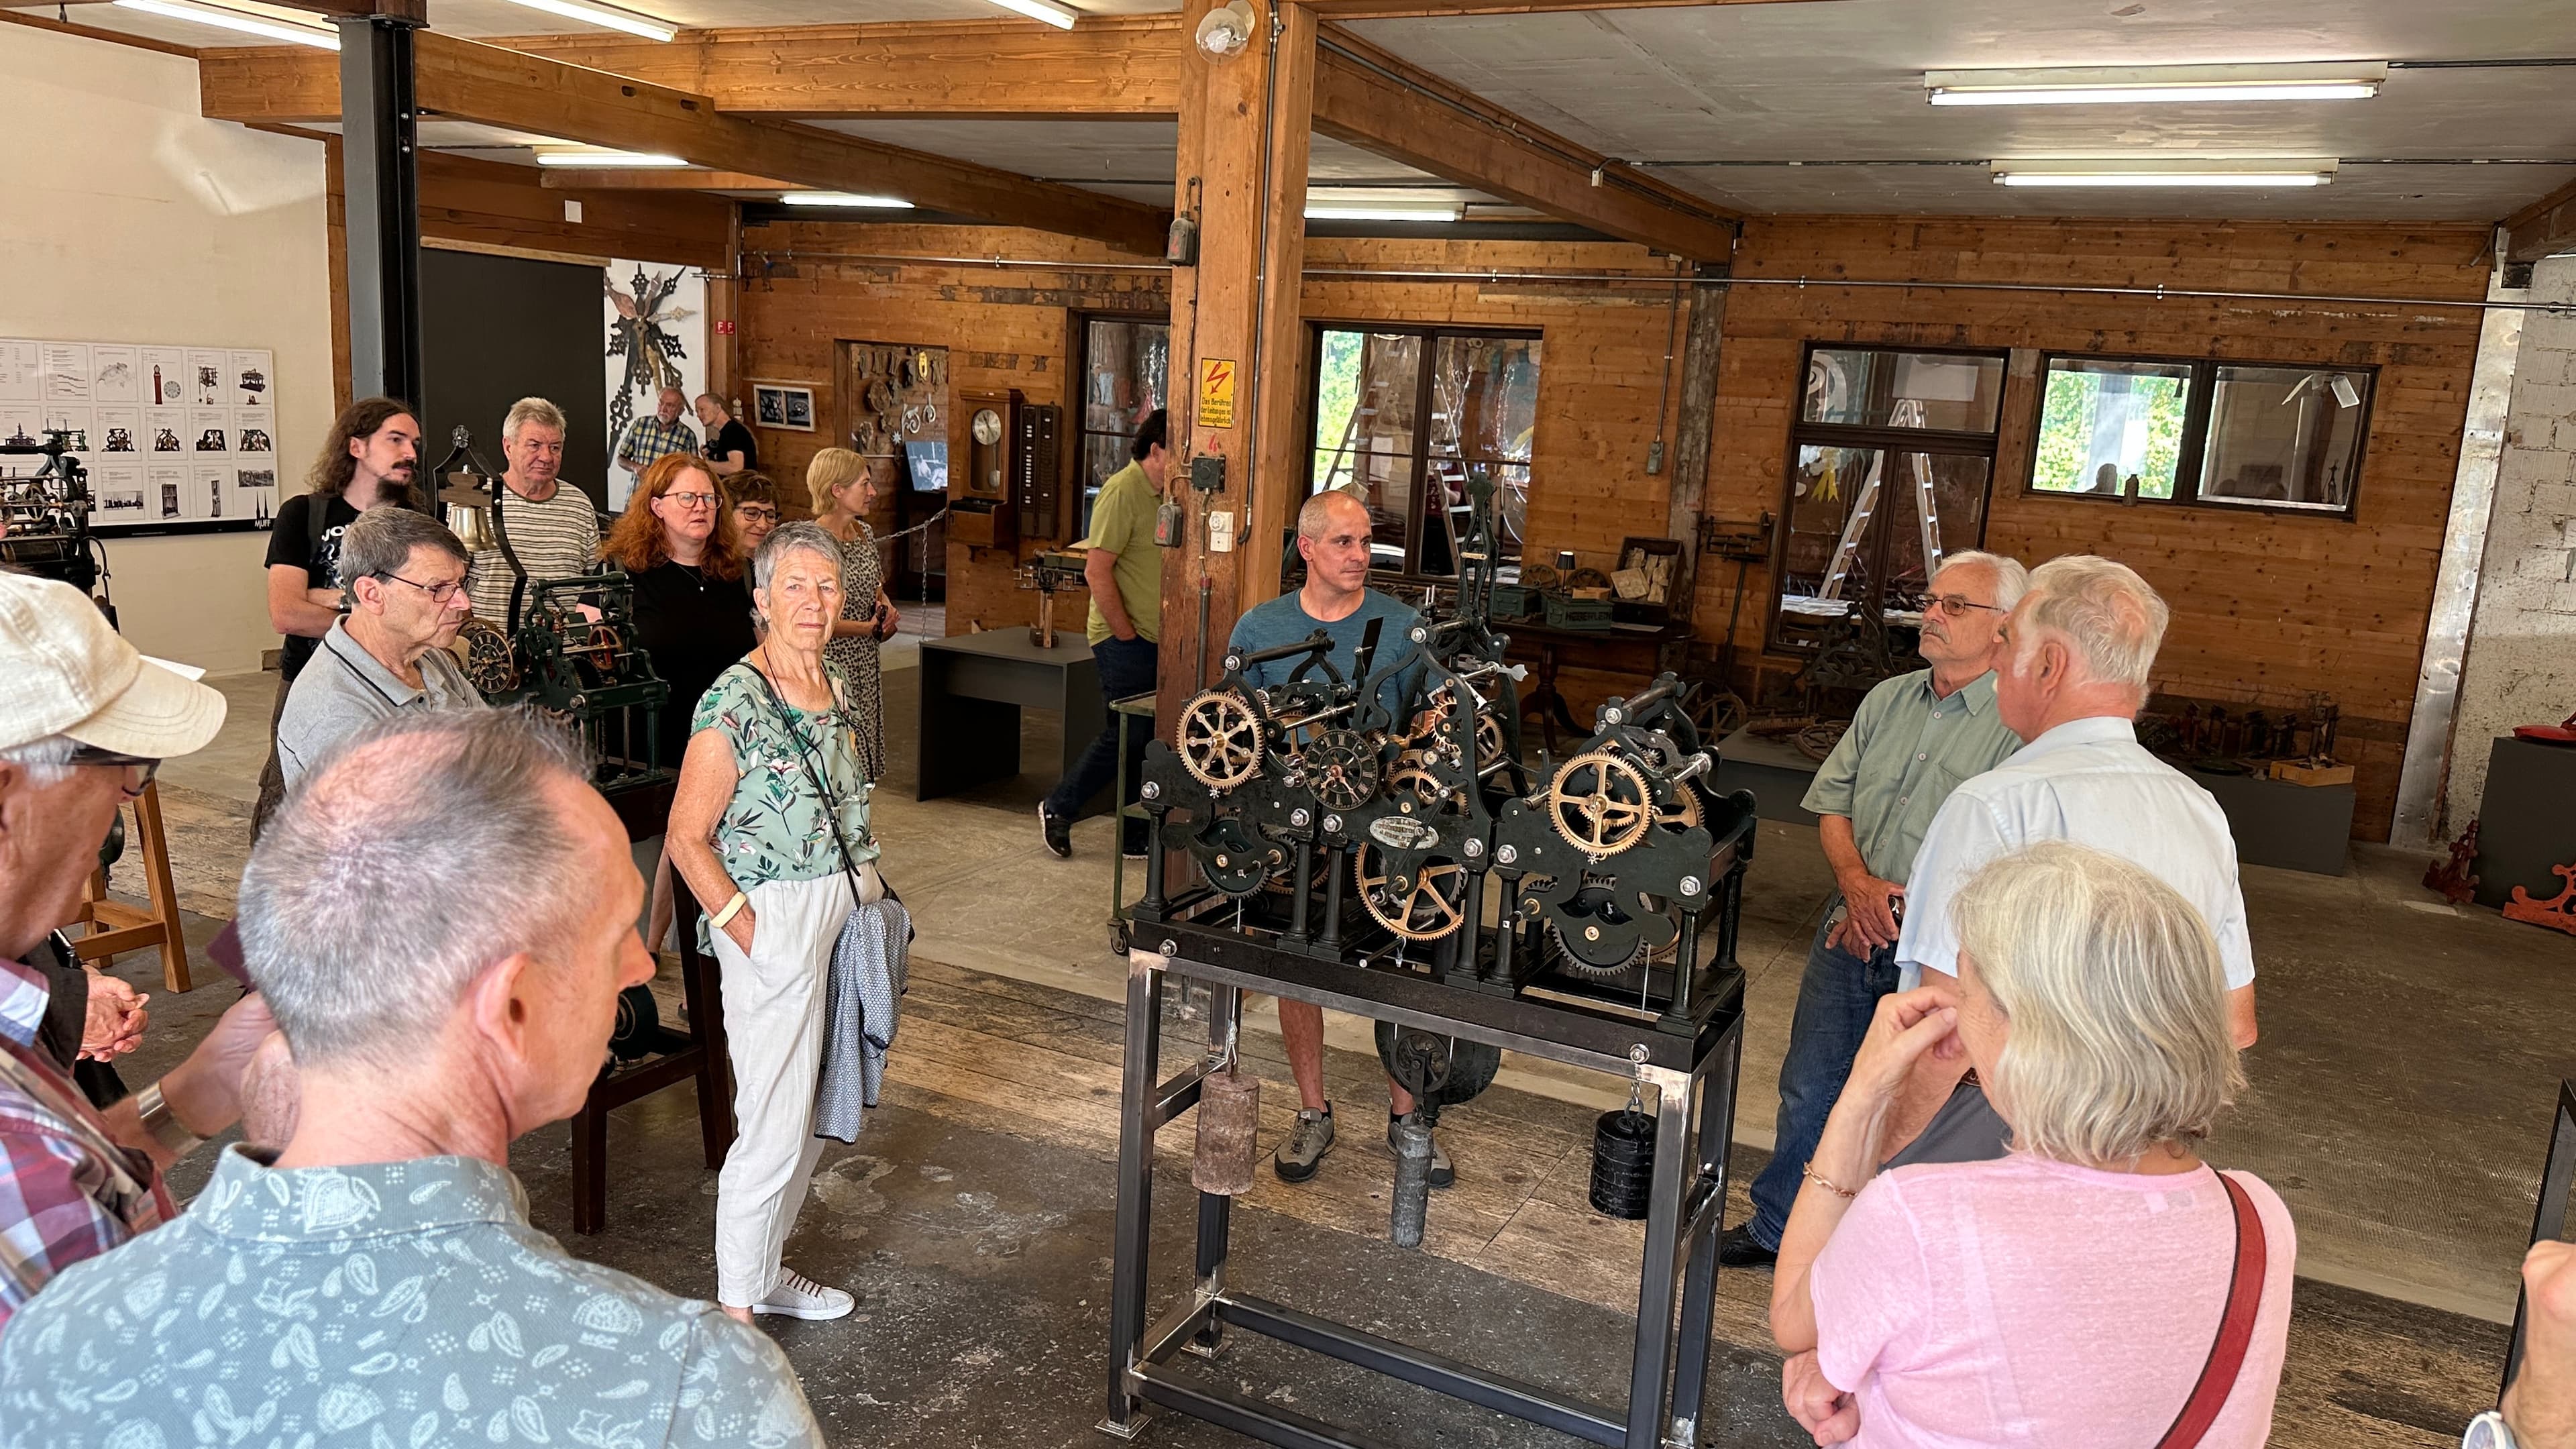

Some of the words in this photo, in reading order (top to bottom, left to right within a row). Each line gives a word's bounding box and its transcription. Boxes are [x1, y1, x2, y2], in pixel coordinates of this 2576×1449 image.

[1212, 397, 1231, 407] Berühren
[1208, 406, 1226, 415] Leitungen
[255, 519, 271, 529] MUFF
[322, 525, 350, 541] JO
